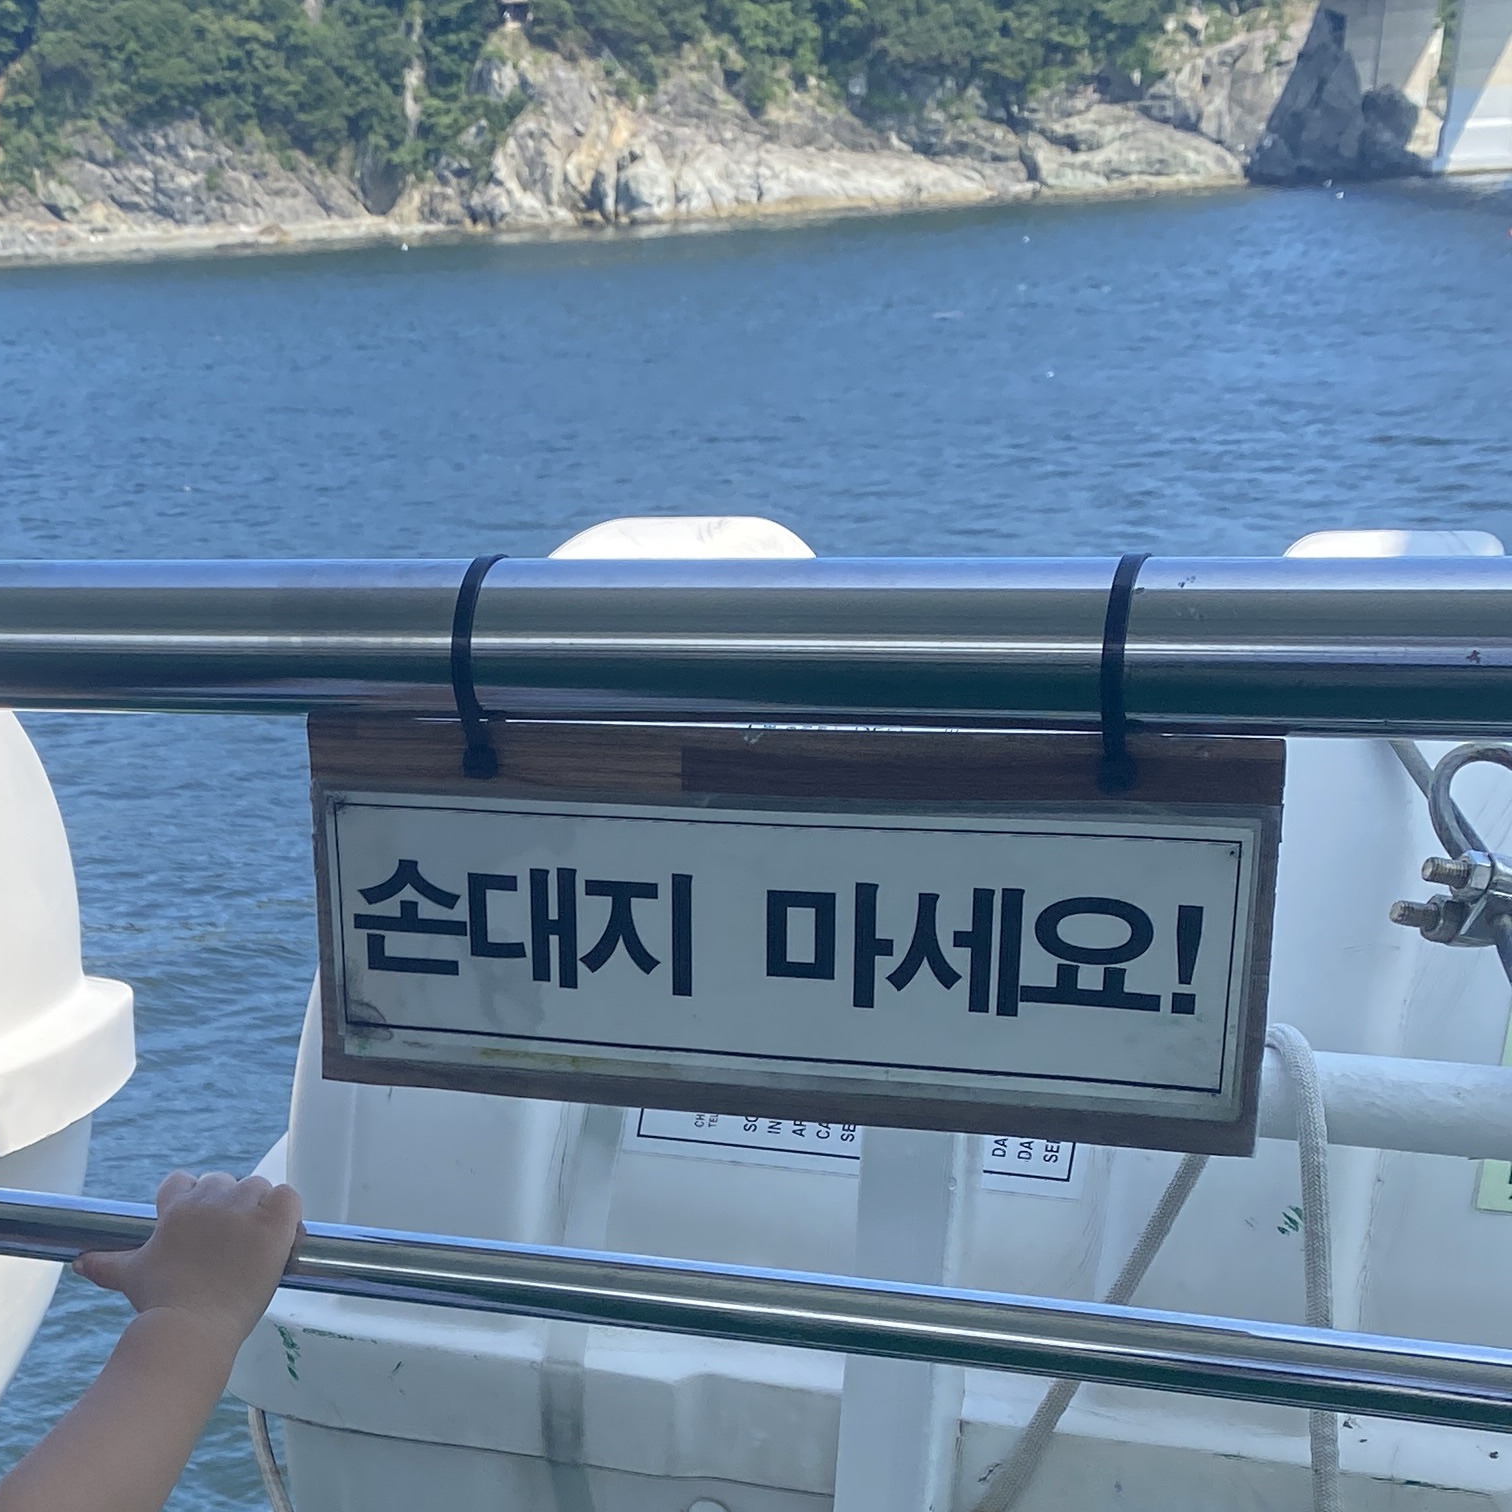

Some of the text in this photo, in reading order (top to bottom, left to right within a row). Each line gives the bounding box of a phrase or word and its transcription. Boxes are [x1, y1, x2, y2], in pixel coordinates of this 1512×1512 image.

[353, 859, 1204, 1018] 손대지 마세요!
[767, 1120, 783, 1135] IN
[840, 1124, 856, 1143] SE
[991, 1138, 1008, 1158] DA
[1017, 1140, 1035, 1161] DA
[1043, 1139, 1061, 1163] SE
